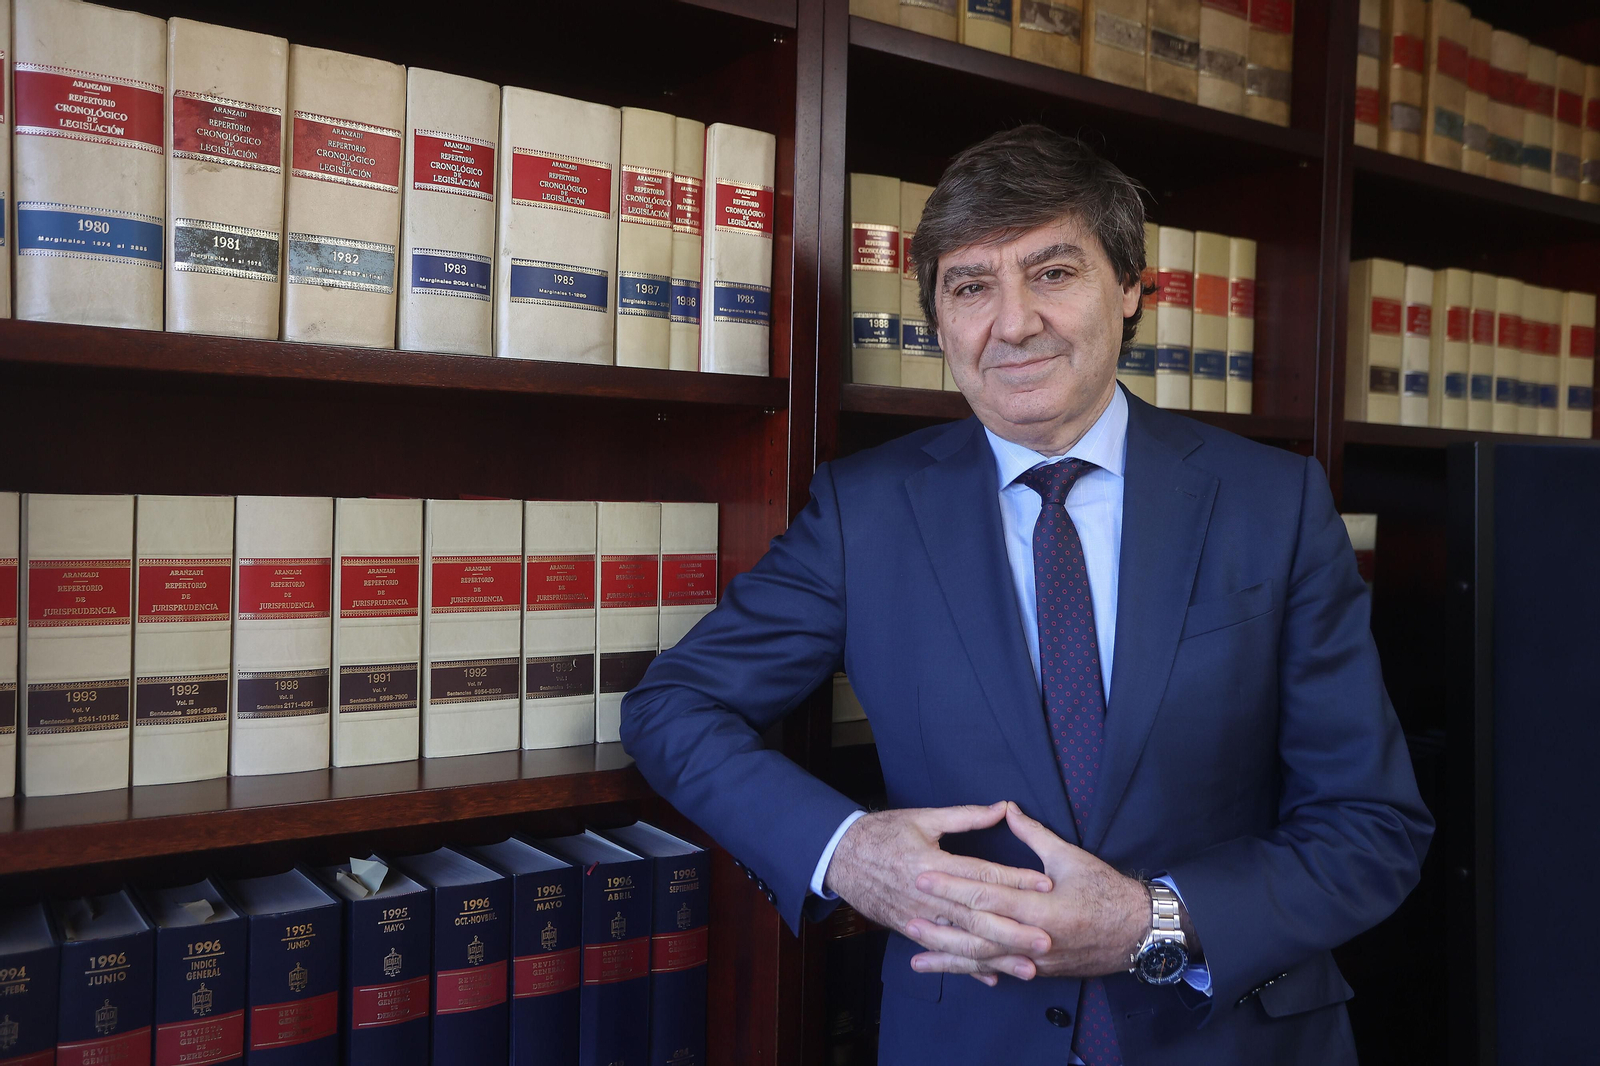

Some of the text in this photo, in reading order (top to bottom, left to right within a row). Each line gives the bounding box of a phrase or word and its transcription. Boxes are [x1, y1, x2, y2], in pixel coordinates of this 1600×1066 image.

[73, 80, 111, 92] ARANZADI
[69, 94, 116, 108] REPERTORIO
[55, 103, 128, 122] CRONOLÓGICO
[213, 106, 247, 117] ARANZADI
[60, 119, 124, 135] LEGISLACIÓN
[208, 118, 250, 132] REPERTORIO
[196, 128, 262, 146] CRONOLÓGICO
[332, 128, 363, 139] ARANZADI
[200, 143, 258, 159] LEGISLACIÓN
[327, 140, 366, 153] REPERTORIO
[444, 141, 471, 151] ARANZADI
[316, 148, 376, 166] CRONOLÓGICO
[440, 153, 474, 164] REPERTORIO
[319, 163, 372, 178] LEGISLACIÓN
[430, 161, 483, 177] CRONOLÓGICO
[552, 161, 577, 171] ARANZADI
[433, 175, 480, 188] LEGISLACIÓN
[549, 172, 580, 183] REPERTORIO
[637, 174, 662, 184] ARANZADI
[540, 180, 588, 194] CRONOLÓGICO
[634, 186, 665, 196] REPERTORIO
[735, 188, 757, 197] ARANZADI
[542, 193, 585, 206] LEGISLACIÓN
[626, 194, 672, 207] CRONOLÓGICO
[733, 198, 760, 208] REPERTORIO
[628, 206, 670, 218] LEGISLACIÓN
[725, 206, 765, 218] CRONOLÓGICO
[77, 219, 110, 234] 1980
[728, 218, 764, 229] LEGISLACIÓN
[38, 235, 86, 245] Marginales
[213, 235, 240, 250] 1981
[332, 251, 359, 265] 1982
[444, 262, 467, 275] 1983
[419, 277, 452, 285] Marginales
[553, 274, 574, 286] 1985
[539, 288, 567, 296] Marginales
[636, 283, 660, 295] 1987
[676, 295, 696, 307] 1986
[737, 294, 755, 304] 1985
[869, 319, 889, 329] 1988
[259, 602, 315, 610] JURISPRUDENCIA
[352, 599, 408, 608] JURISPRUDENCIA
[450, 596, 503, 604] JURISPRUDENCIA
[43, 606, 117, 617] JURISPRUDENCIA
[151, 604, 218, 613] JURISPRUDENCIA
[367, 672, 391, 684] 1991
[464, 668, 487, 678] 1992
[170, 684, 199, 696] 1992
[274, 680, 298, 691] 1998
[65, 690, 97, 703] 1993
[673, 868, 696, 880] 1996
[607, 876, 632, 888] 1996
[669, 881, 699, 894] SEPTIEMBRE
[537, 884, 563, 897] 1996
[608, 891, 631, 901] ABRIL
[463, 897, 490, 910] 1996
[536, 900, 562, 912] MAYO
[382, 907, 408, 921] 1995
[286, 923, 313, 937] 1995
[384, 922, 405, 933] MAYO
[187, 940, 221, 955] 1996
[287, 940, 310, 950] JUNIO
[90, 952, 126, 969] 1996
[191, 959, 217, 971] INDICE
[88, 972, 126, 986] JUNIO
[186, 968, 221, 981] GENERAL
[180, 1024, 223, 1038] REVISTA
[180, 1032, 222, 1046] GENERAL
[180, 1048, 222, 1062] DERECHO
